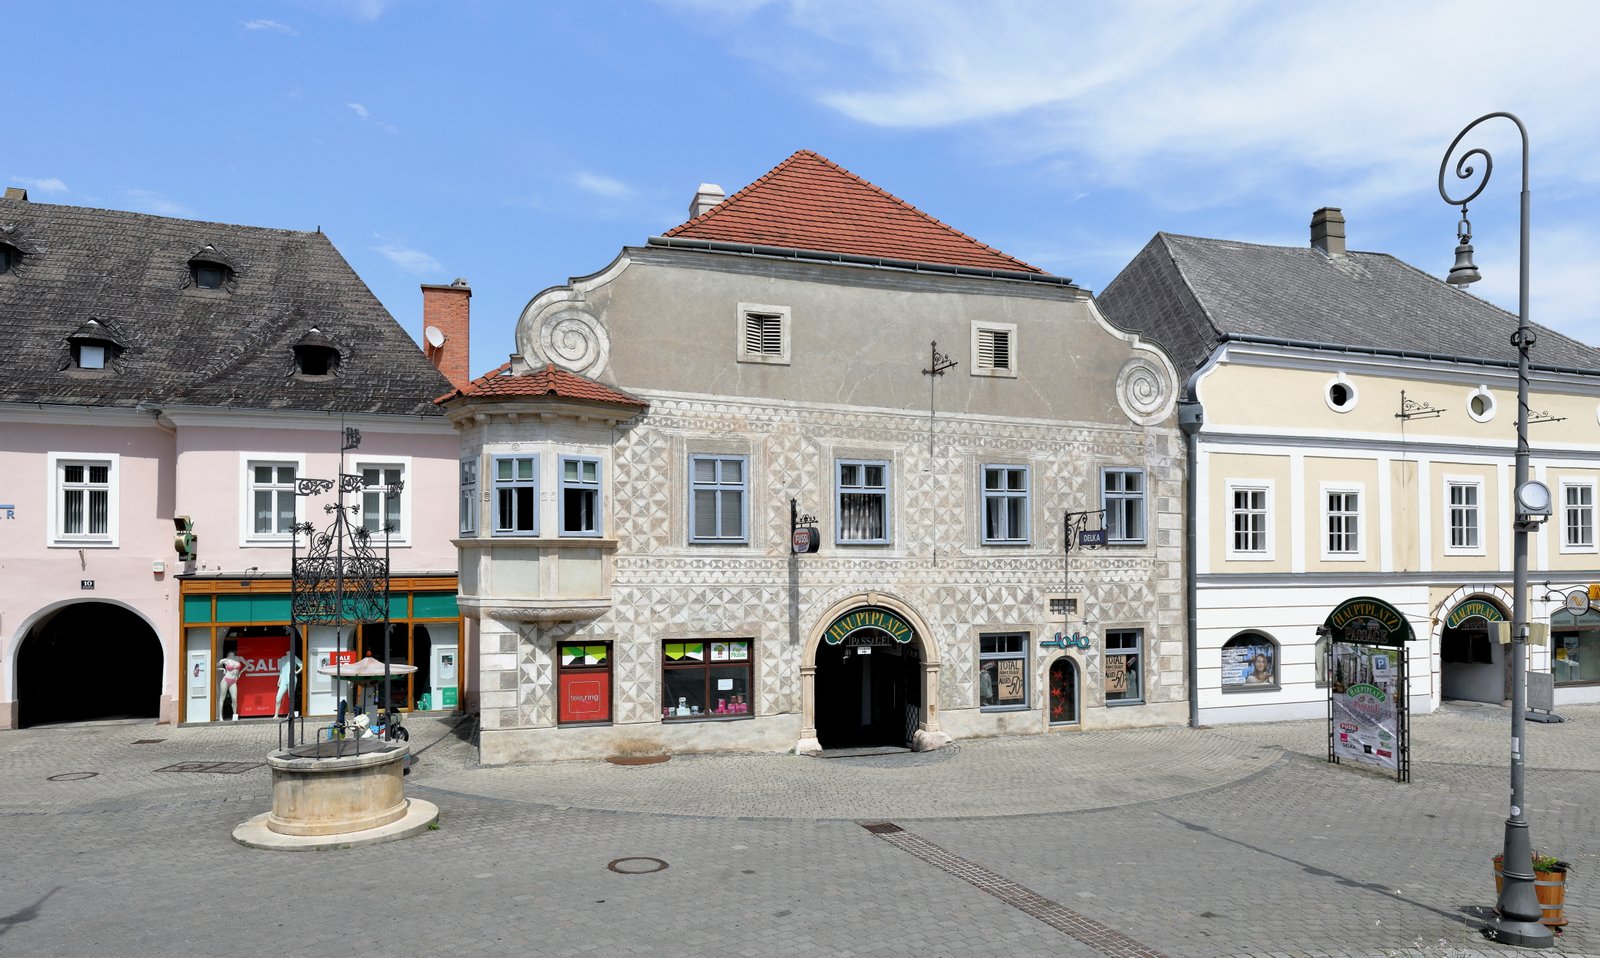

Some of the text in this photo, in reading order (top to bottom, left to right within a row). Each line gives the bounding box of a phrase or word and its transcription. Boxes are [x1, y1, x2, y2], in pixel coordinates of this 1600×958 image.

[1083, 534, 1101, 543] DELKA
[1334, 604, 1398, 628] HAUPTPLATZ
[1451, 604, 1499, 624] HAUPTPLATZ
[829, 611, 909, 640] HAUPTPLATZ
[852, 636, 887, 646] PASSAGE
[1345, 626, 1389, 644] PASSAGE
[1000, 660, 1020, 670] TOTAL
[1378, 659, 1384, 668] P
[1350, 687, 1384, 700] HAUPTPLATZ
